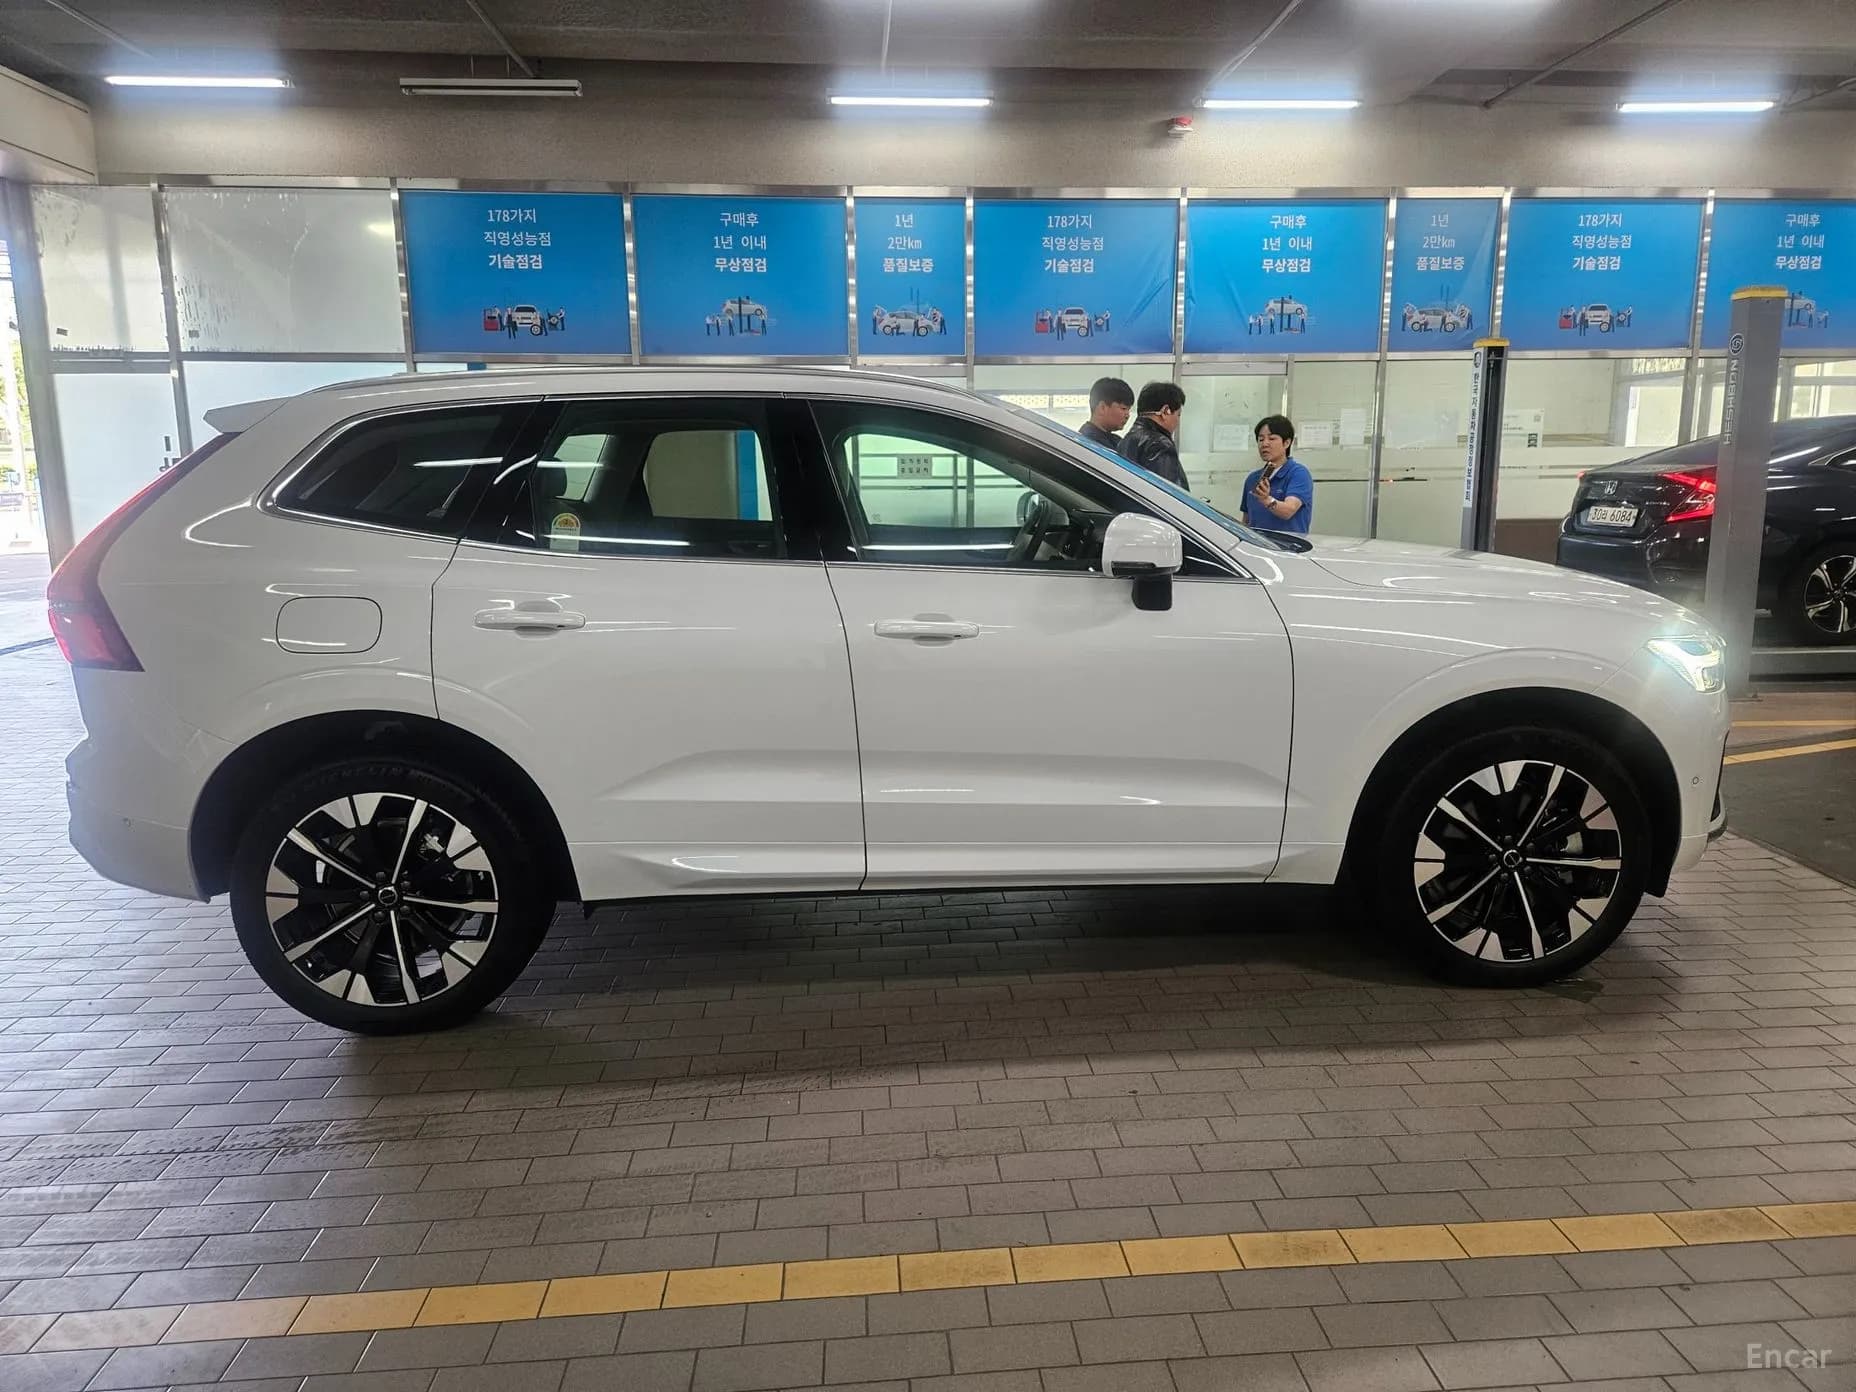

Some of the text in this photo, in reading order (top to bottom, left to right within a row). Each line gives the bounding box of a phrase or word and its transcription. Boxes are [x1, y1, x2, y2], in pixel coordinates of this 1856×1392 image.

[487, 208, 537, 224] 178가지
[719, 212, 759, 228] 구매후
[895, 213, 914, 229] 1년
[1047, 214, 1093, 230] 178가지
[1269, 214, 1307, 229] 구매후
[1431, 213, 1449, 228] 1년
[1578, 213, 1623, 228] 178가지
[1785, 213, 1821, 228] 구매후
[483, 231, 552, 247] 직영성능점
[713, 234, 767, 250] 1년 이내
[1042, 236, 1105, 252] 직영성능점
[1262, 236, 1313, 252] 1년 이내
[1572, 234, 1632, 249] 직영성능점
[1776, 234, 1825, 249] 1년 이내
[488, 253, 543, 270] 기술점검
[714, 257, 767, 273] 무상점검
[882, 257, 934, 273] 품질보증
[1044, 258, 1094, 274] 기술점검
[1262, 257, 1311, 273] 무상점검
[1416, 256, 1465, 271] 품질보증
[1572, 255, 1621, 271] 기술점검
[1775, 255, 1822, 270] 무상점검
[1609, 509, 1633, 522] 6084
